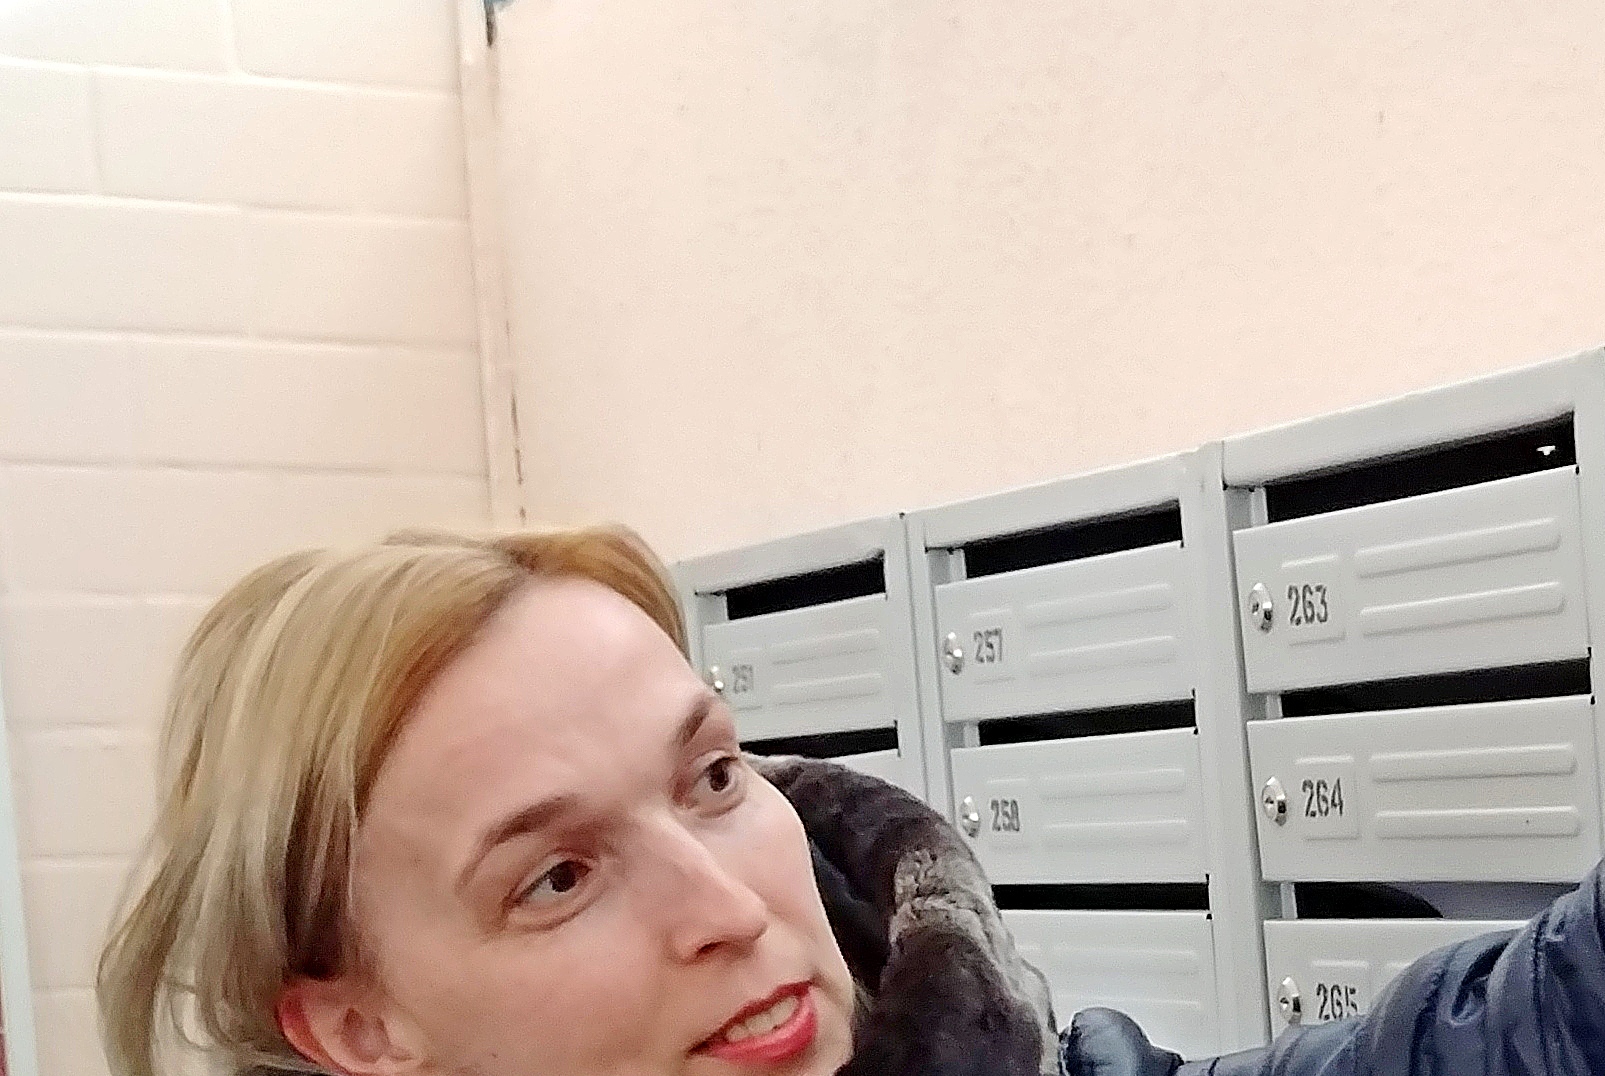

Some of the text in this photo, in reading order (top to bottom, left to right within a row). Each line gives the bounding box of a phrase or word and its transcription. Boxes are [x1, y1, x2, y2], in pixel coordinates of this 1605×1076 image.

[1288, 584, 1329, 627] 263
[974, 628, 1004, 665] 257
[1303, 777, 1345, 818] 264
